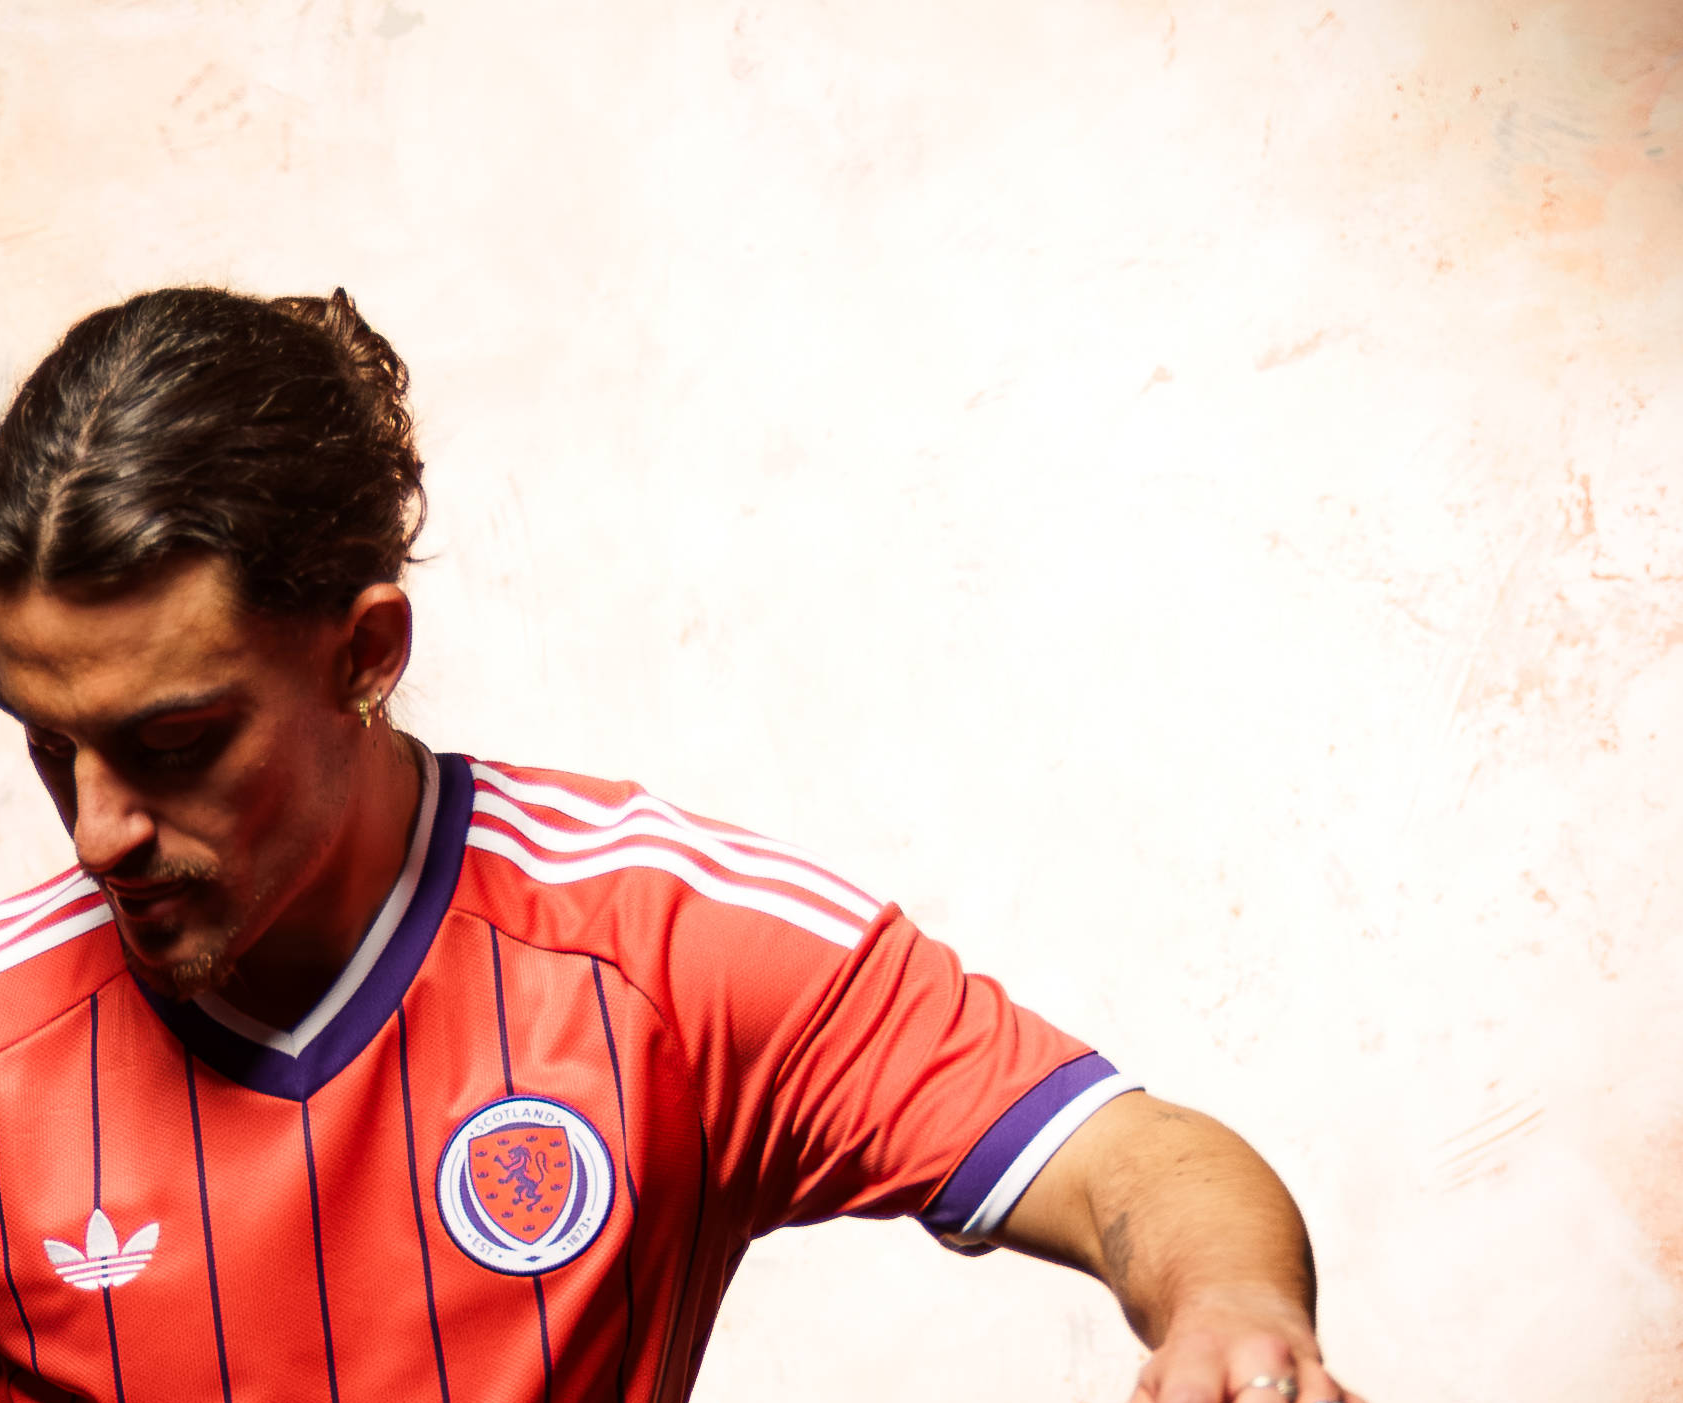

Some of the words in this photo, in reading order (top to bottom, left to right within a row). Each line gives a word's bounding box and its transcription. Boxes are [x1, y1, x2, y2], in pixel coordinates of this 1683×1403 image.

[475, 1108, 555, 1132] SCOTLAND
[471, 1236, 494, 1256] EST
[566, 1222, 590, 1247] 1873
